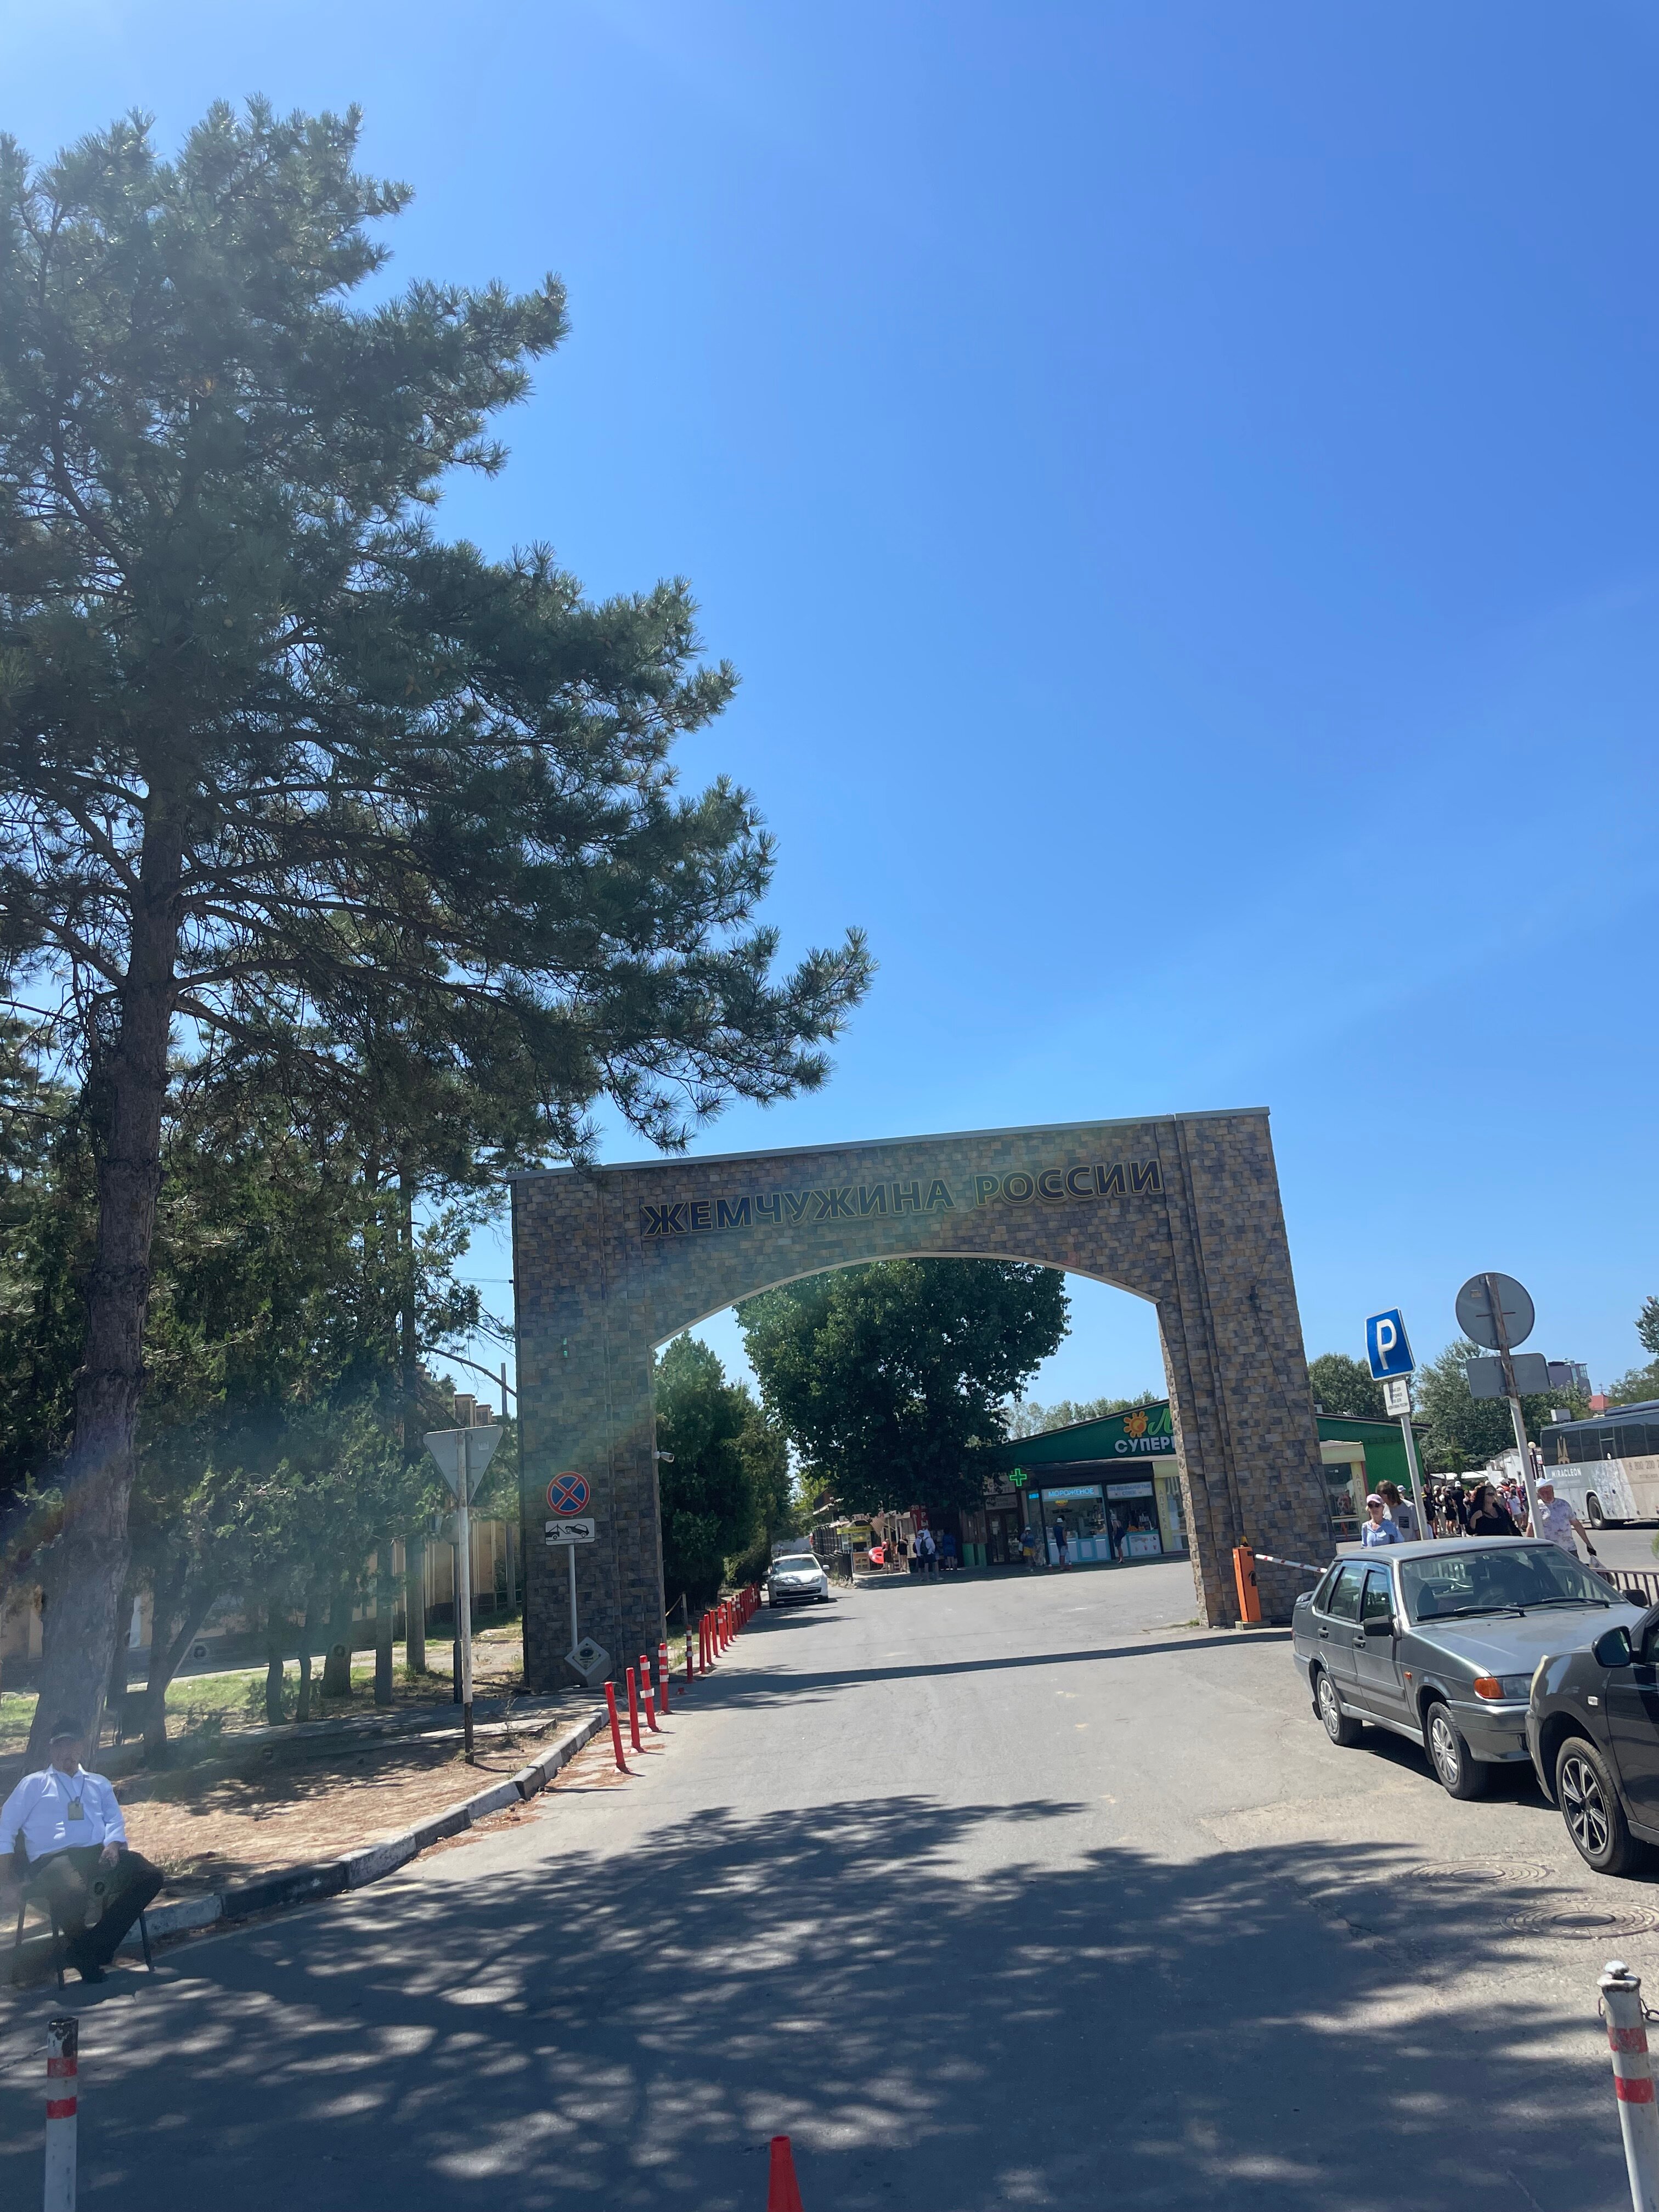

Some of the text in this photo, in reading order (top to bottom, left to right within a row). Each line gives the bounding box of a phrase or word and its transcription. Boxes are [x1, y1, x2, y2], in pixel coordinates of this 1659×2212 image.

[641, 1160, 1162, 1236] ЖЕМЧУЖИНА РОССИИ
[1376, 1318, 1397, 1370] P
[1551, 1467, 1582, 1479] MIRACLEON
[1048, 1487, 1094, 1497] МОРОЖЕНОЕ
